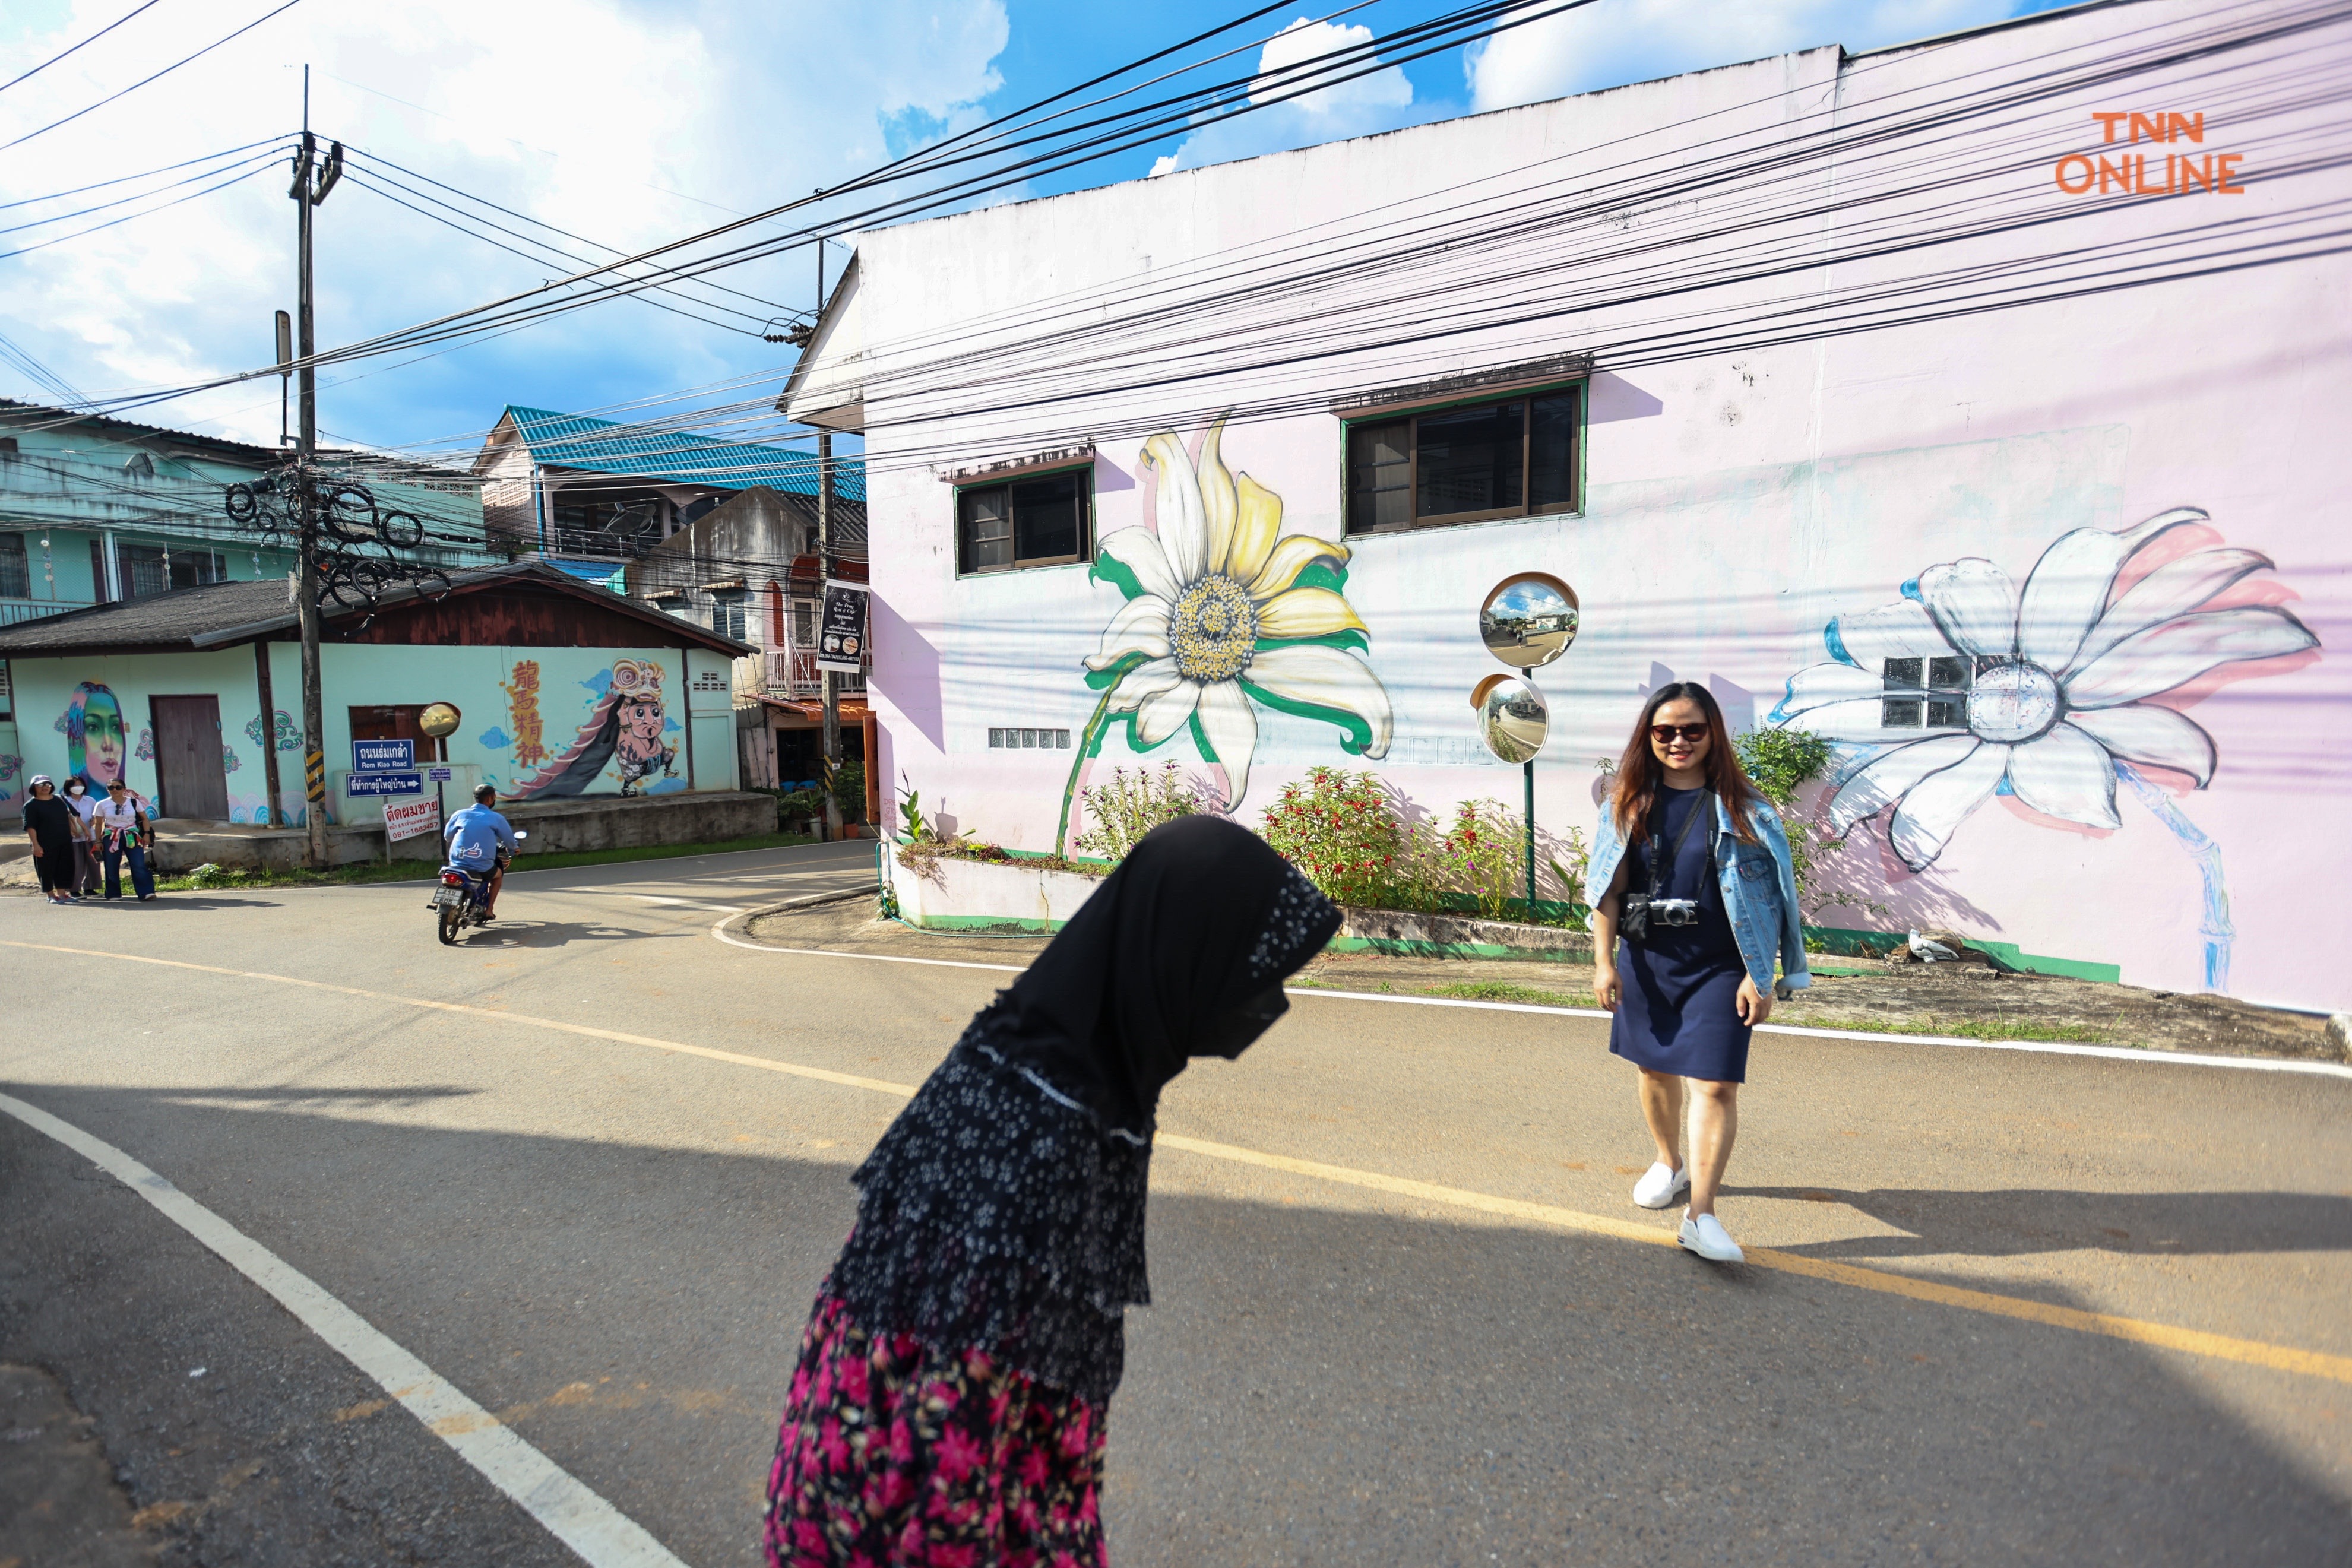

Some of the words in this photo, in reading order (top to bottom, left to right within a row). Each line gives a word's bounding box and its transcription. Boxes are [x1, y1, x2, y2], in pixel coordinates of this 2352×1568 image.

[512, 660, 543, 769] 龍馬精神
[360, 742, 407, 759] ถนนร่มเกล้า
[351, 777, 406, 793] ที่ทำการผู้ใหญ่บ้าน
[387, 800, 438, 822] ตัดผมชาย
[392, 822, 438, 838] 081-1683457
